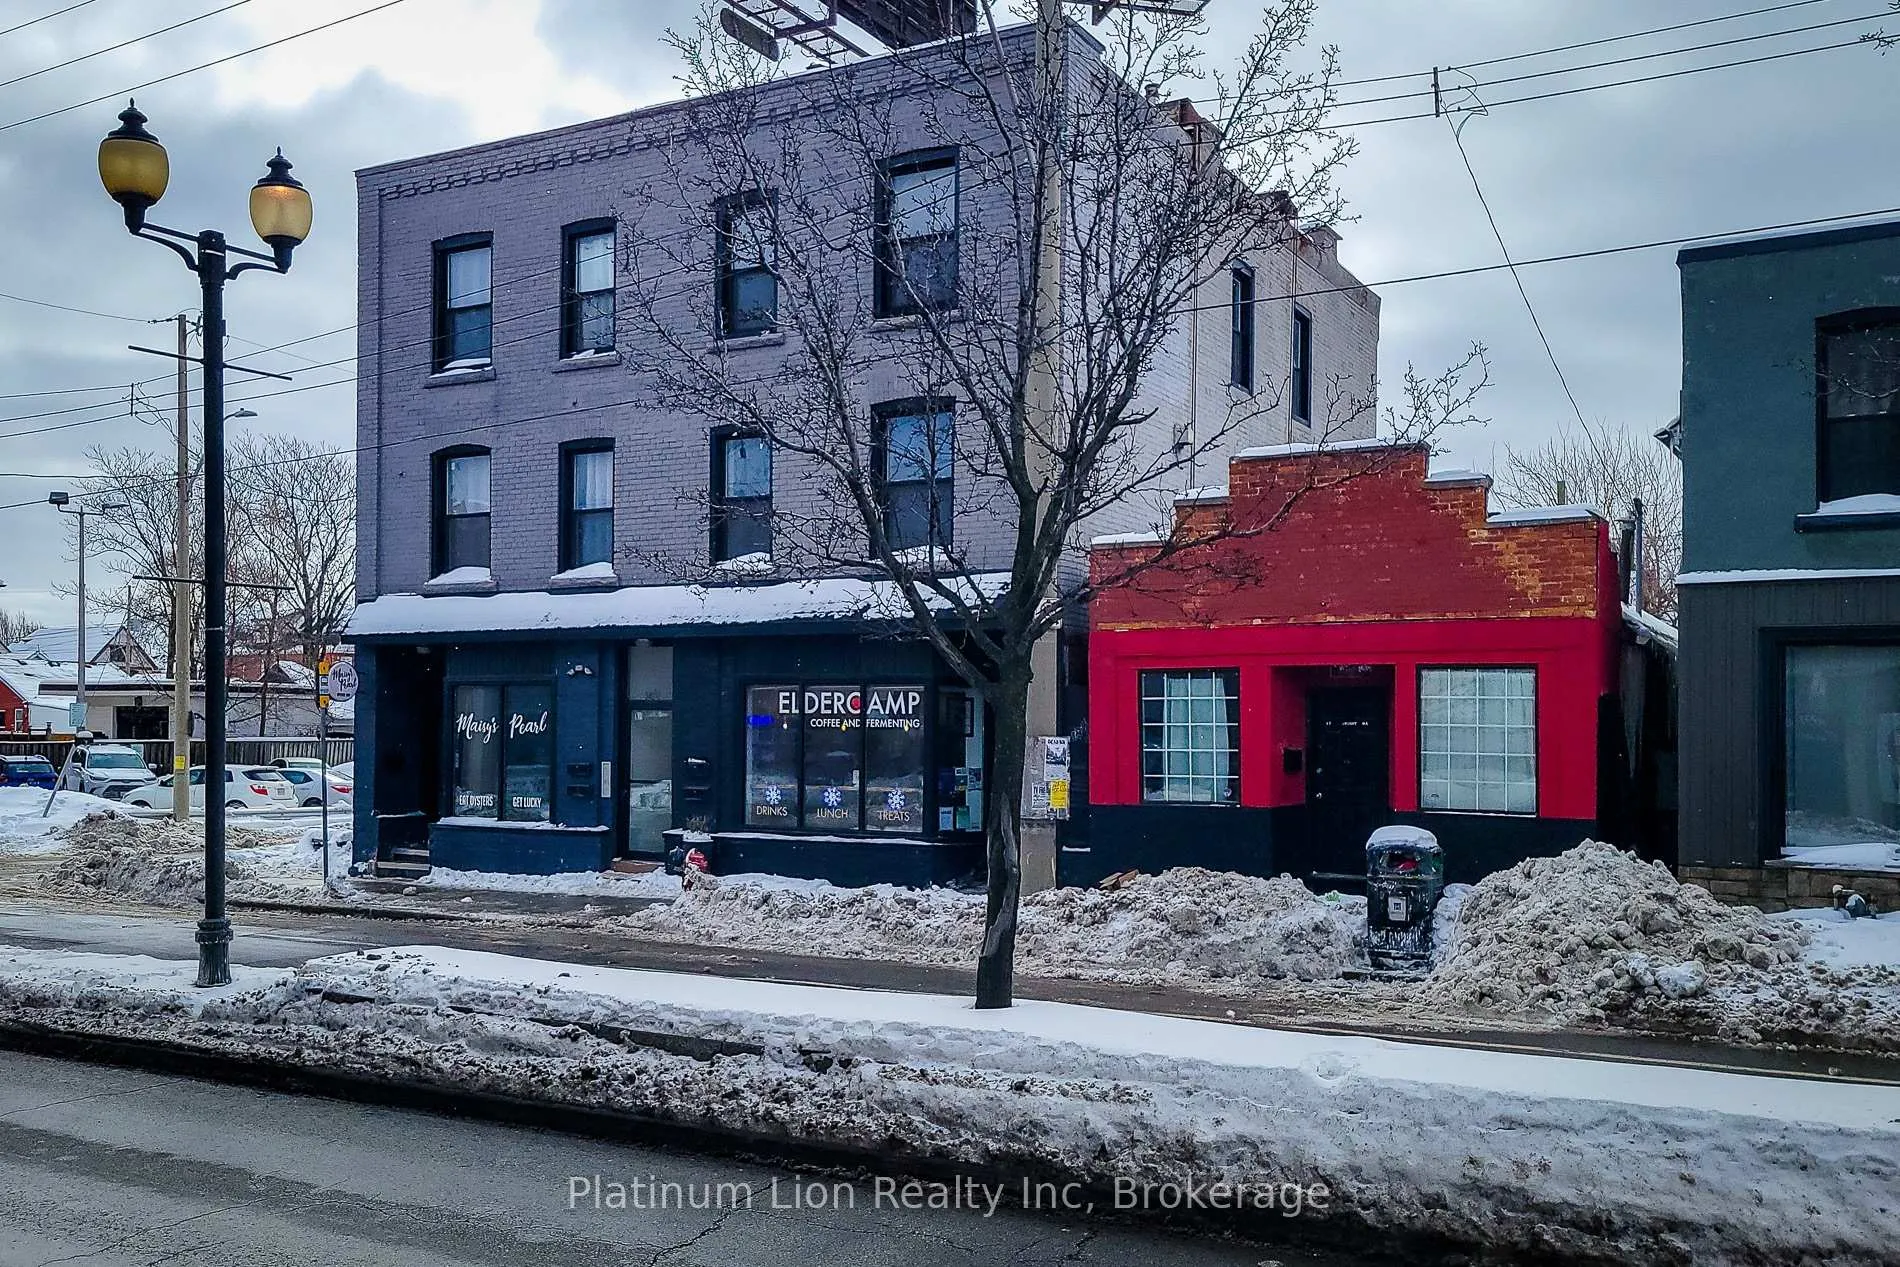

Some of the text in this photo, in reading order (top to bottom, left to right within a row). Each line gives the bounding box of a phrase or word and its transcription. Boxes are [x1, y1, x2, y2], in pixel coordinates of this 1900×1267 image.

[456, 711, 548, 744] Maisy's Pearl
[810, 718, 921, 729] COFFEE AND FERMENTING
[459, 795, 494, 807] EAT OYSTERS
[512, 796, 542, 809] GET LUCKY
[756, 805, 788, 817] DRINKS
[816, 808, 849, 819] LUNCH
[877, 810, 911, 822] TREATS
